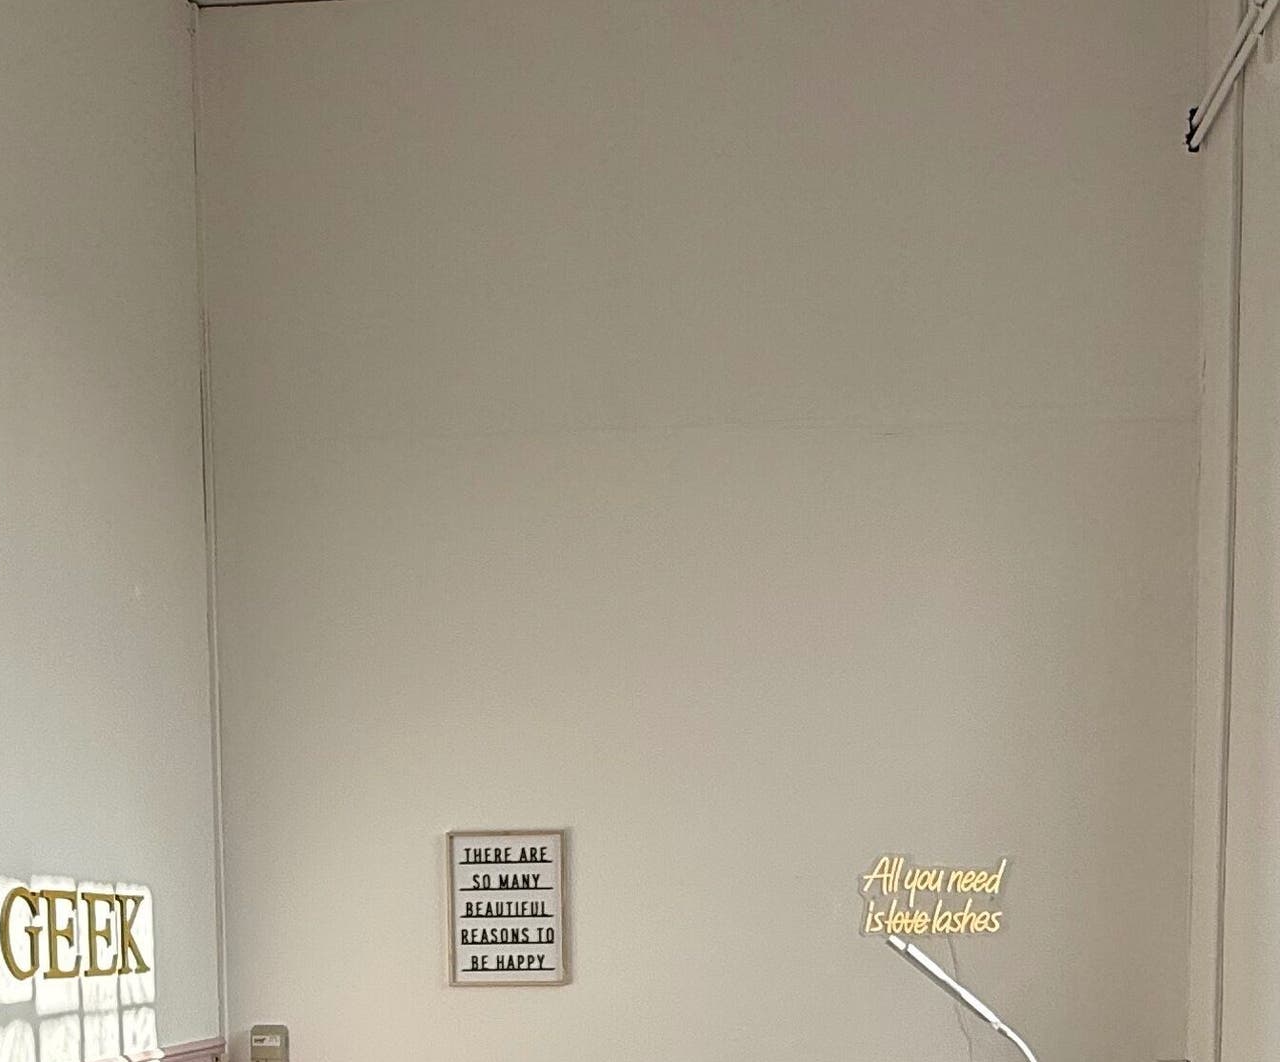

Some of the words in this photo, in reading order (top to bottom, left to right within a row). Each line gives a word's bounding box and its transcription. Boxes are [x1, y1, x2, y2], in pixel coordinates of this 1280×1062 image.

[463, 848, 512, 863] THERE
[519, 847, 548, 862] ARE
[472, 873, 492, 889] SO
[499, 873, 541, 889] MANY
[863, 856, 904, 895] All
[904, 869, 944, 908] you
[947, 858, 1007, 894] need
[465, 901, 547, 917] BEAUTIFUL
[865, 900, 885, 933] is
[885, 899, 931, 934] love
[931, 898, 1003, 934] lashes
[0, 886, 151, 982] GEEK
[461, 928, 529, 944] REASONS
[537, 927, 555, 943] TO
[471, 955, 488, 970] BE
[497, 954, 545, 970] HAPPY
